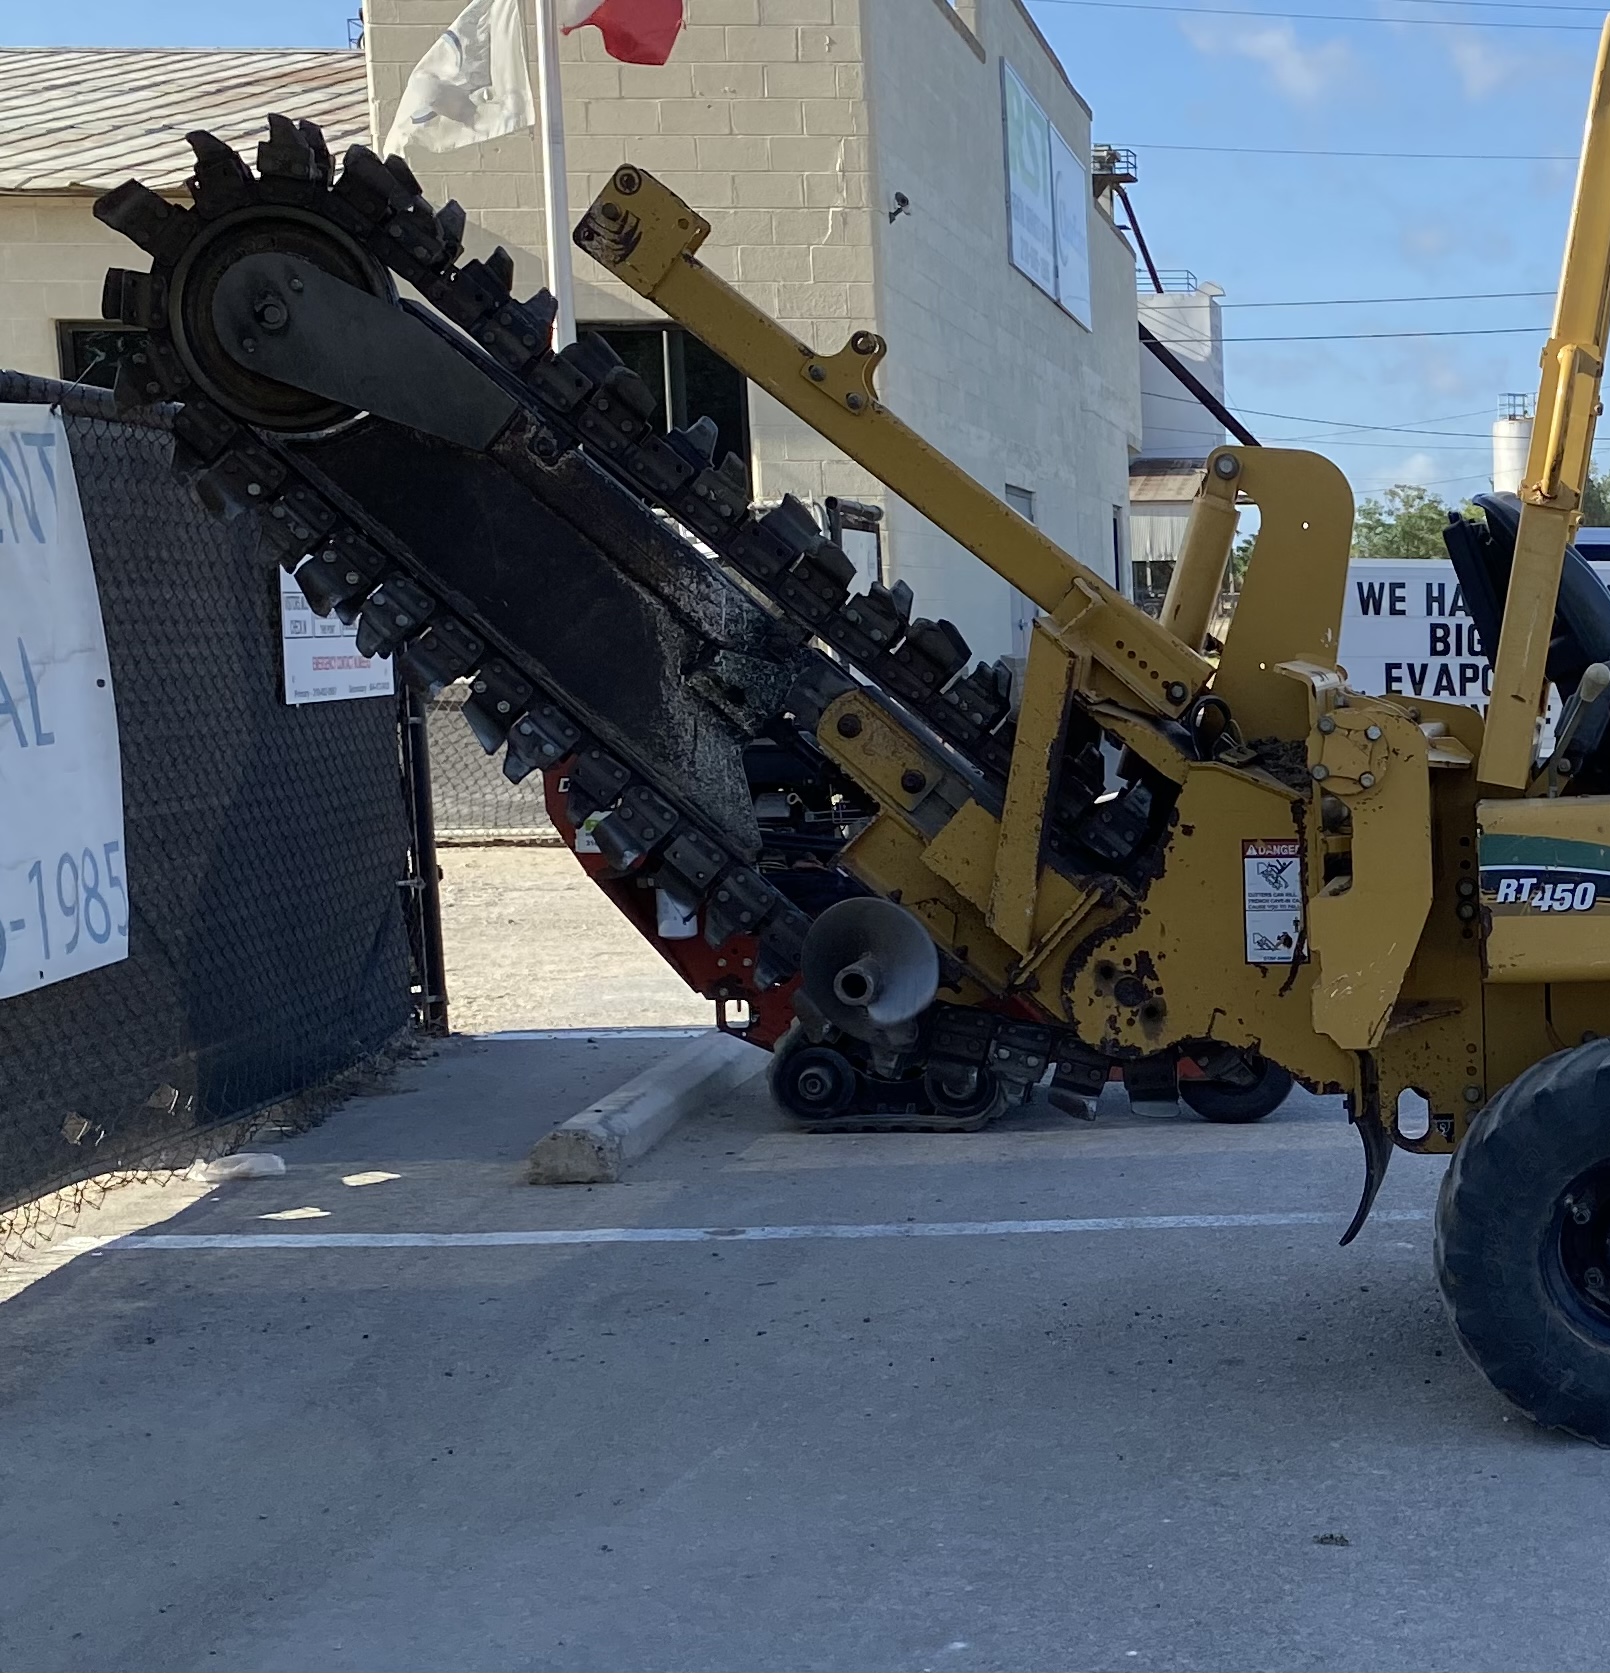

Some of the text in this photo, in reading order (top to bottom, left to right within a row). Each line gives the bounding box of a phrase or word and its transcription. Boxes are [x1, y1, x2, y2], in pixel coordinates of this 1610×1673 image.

[0, 431, 59, 544] NT
[1357, 582, 1406, 616] WE
[1429, 623, 1485, 657] BIG
[0, 840, 128, 973] -1985
